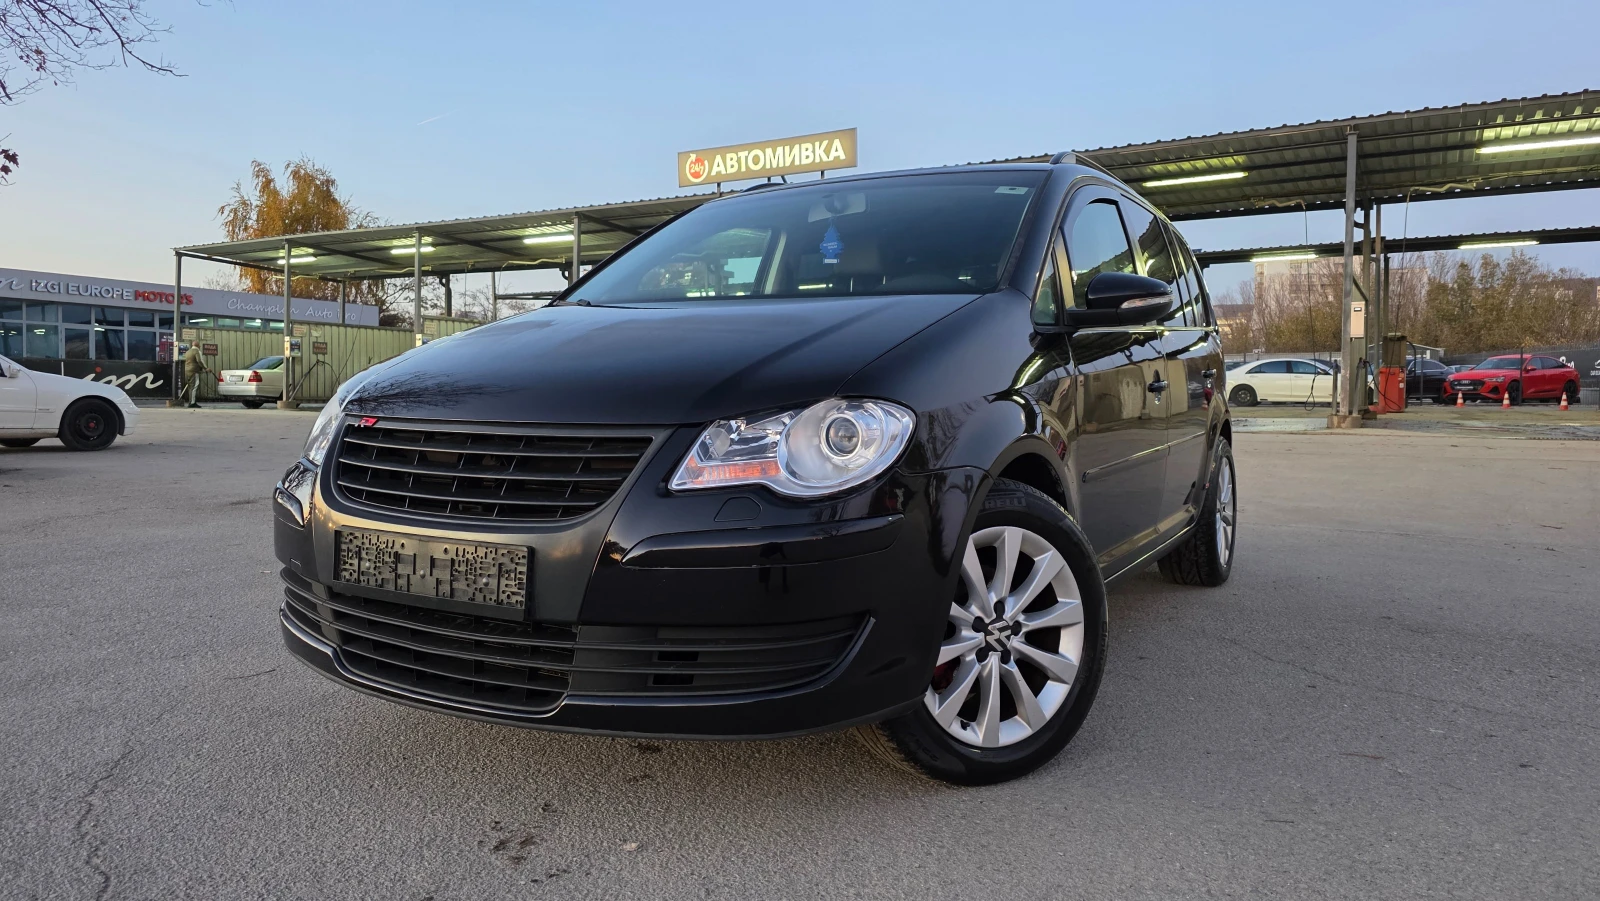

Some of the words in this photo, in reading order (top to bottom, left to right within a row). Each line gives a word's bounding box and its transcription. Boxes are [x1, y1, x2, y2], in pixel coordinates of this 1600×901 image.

[710, 138, 846, 176] АВТОМИВКА
[31, 279, 64, 293] IZGI
[67, 282, 133, 300] EUROPE
[305, 306, 333, 318] Auto
[984, 497, 1026, 509] RELLI
